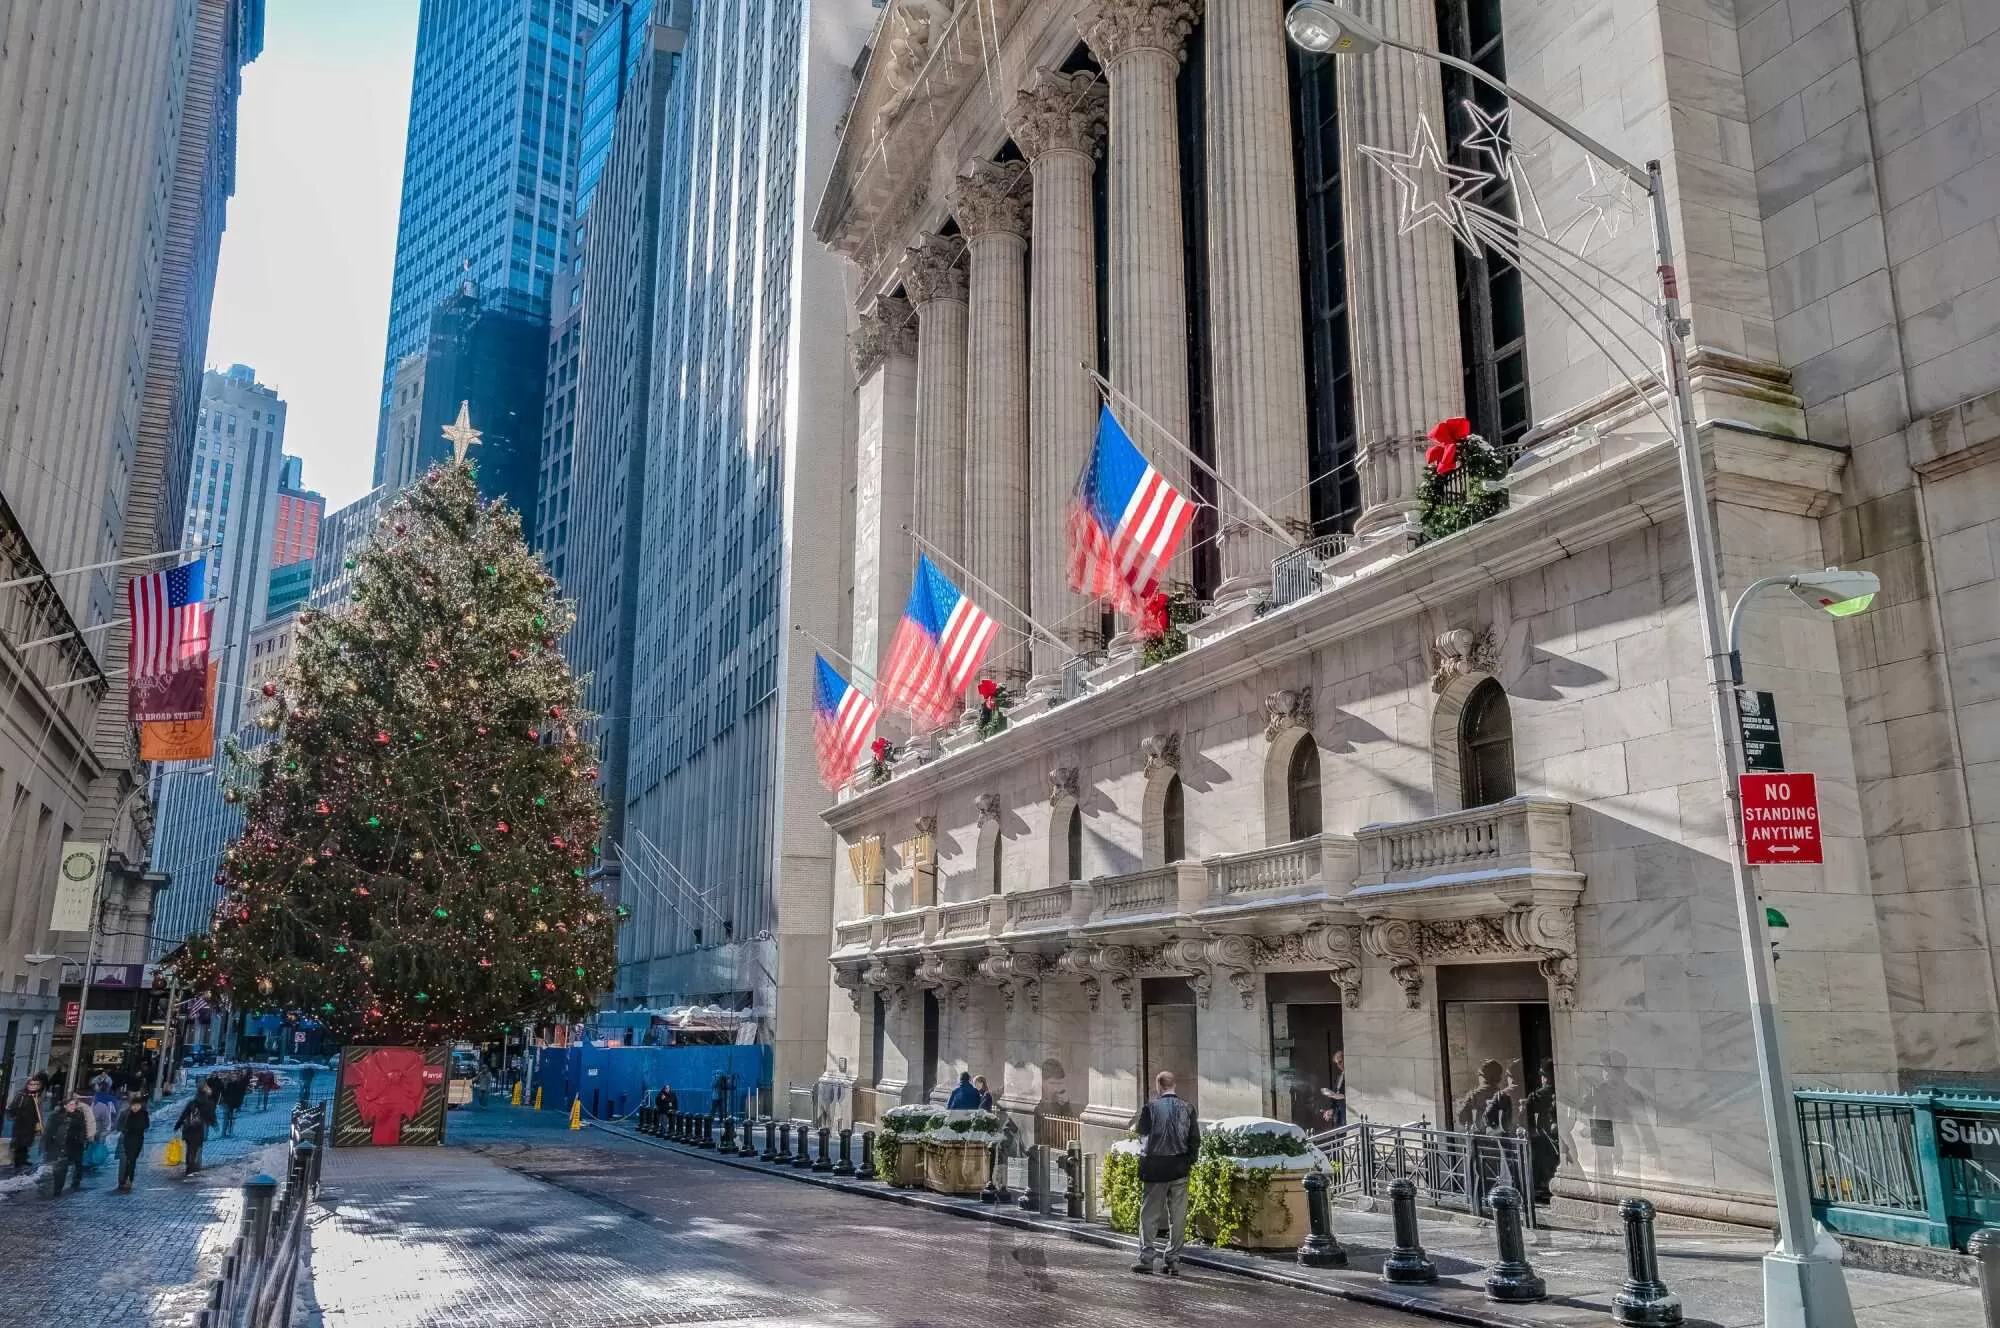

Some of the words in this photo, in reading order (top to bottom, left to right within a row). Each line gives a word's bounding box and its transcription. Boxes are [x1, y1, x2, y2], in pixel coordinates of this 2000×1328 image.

[145, 712, 172, 720] BROAD
[1764, 783, 1791, 801] NO
[1745, 806, 1816, 821] STANDING
[1752, 826, 1814, 840] ANYTIME
